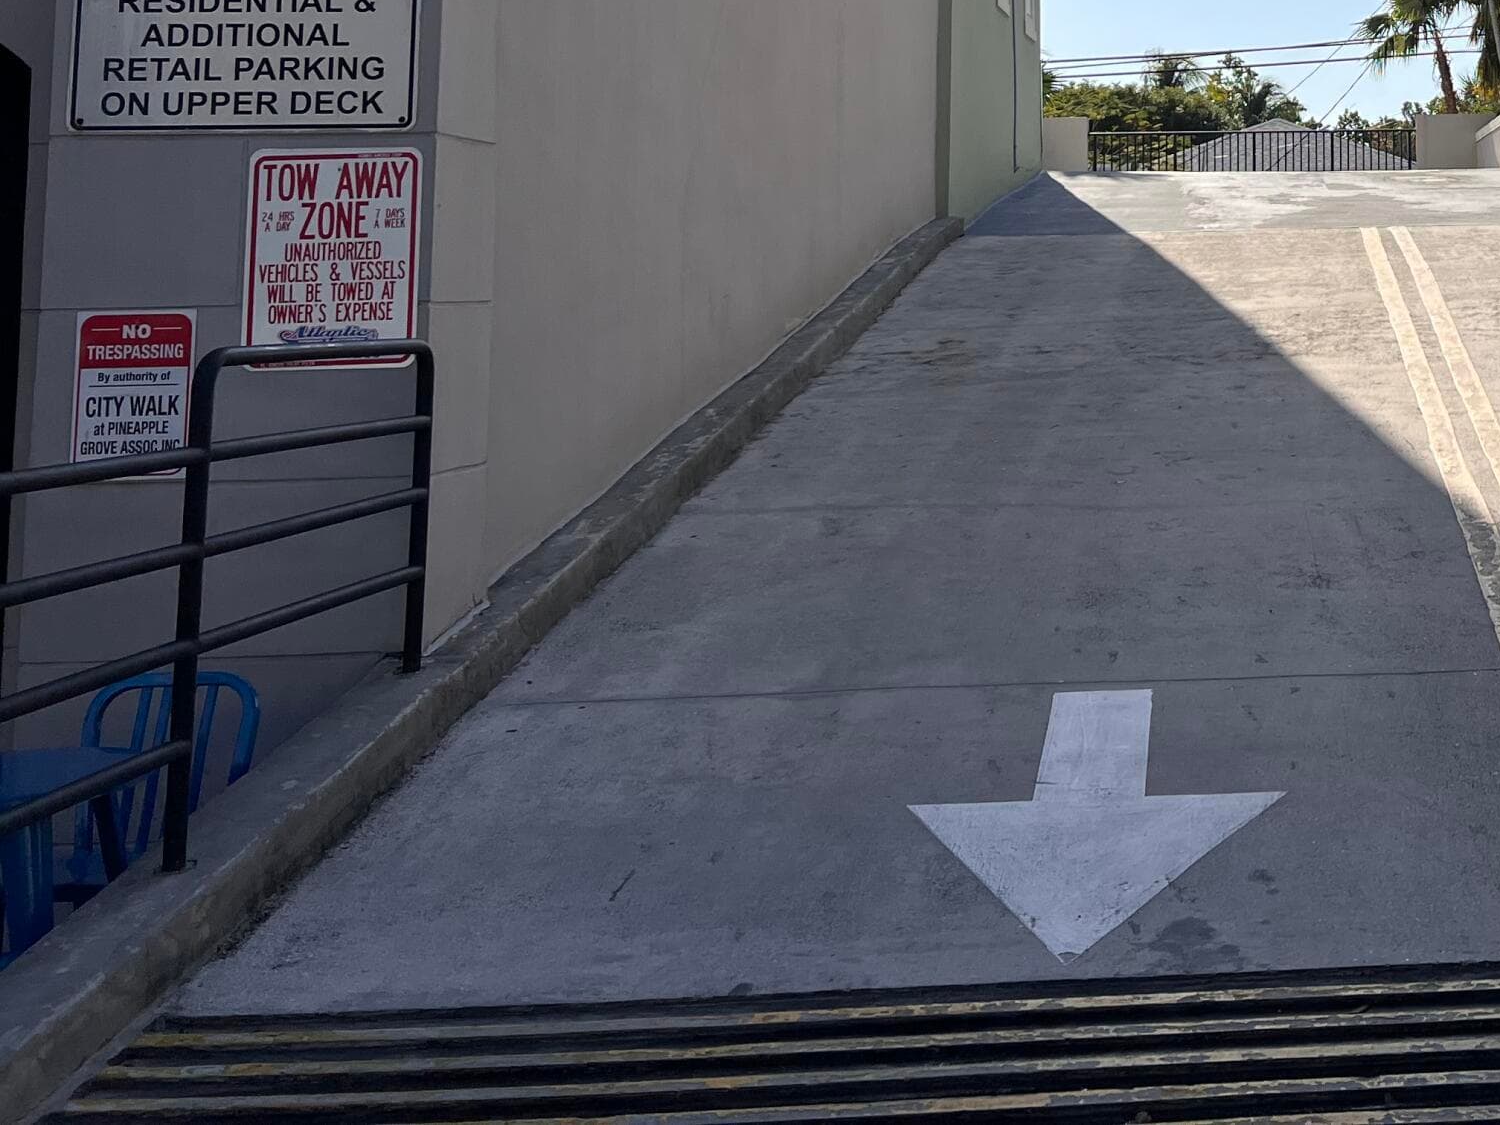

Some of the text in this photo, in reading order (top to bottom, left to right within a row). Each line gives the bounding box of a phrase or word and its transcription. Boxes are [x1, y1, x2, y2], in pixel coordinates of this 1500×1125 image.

[141, 23, 350, 47] ADDITIONAL
[103, 56, 385, 82] RETAIL PARKING
[100, 90, 384, 116] ON UPPER DECK
[263, 161, 409, 202] TOW AWAY
[262, 211, 295, 223] 24 HRS
[299, 201, 369, 240] ZONE
[373, 218, 406, 229] A WEEK
[375, 208, 405, 219] 7 DAYS
[264, 222, 292, 232] A DAY
[284, 241, 382, 262] UNAUTHORIZED
[259, 261, 406, 283] VEHICLES & VESSELS
[267, 281, 397, 304] WILL BE TOWED AT
[268, 302, 394, 324] OWNER'S EXPENSE
[122, 324, 151, 339] NO
[87, 344, 183, 360] TRESPASSING
[97, 371, 171, 384] By authority of
[86, 395, 179, 418] CITY WALK
[94, 421, 169, 436] at PINEAPPLE
[80, 441, 117, 455] GROVE
